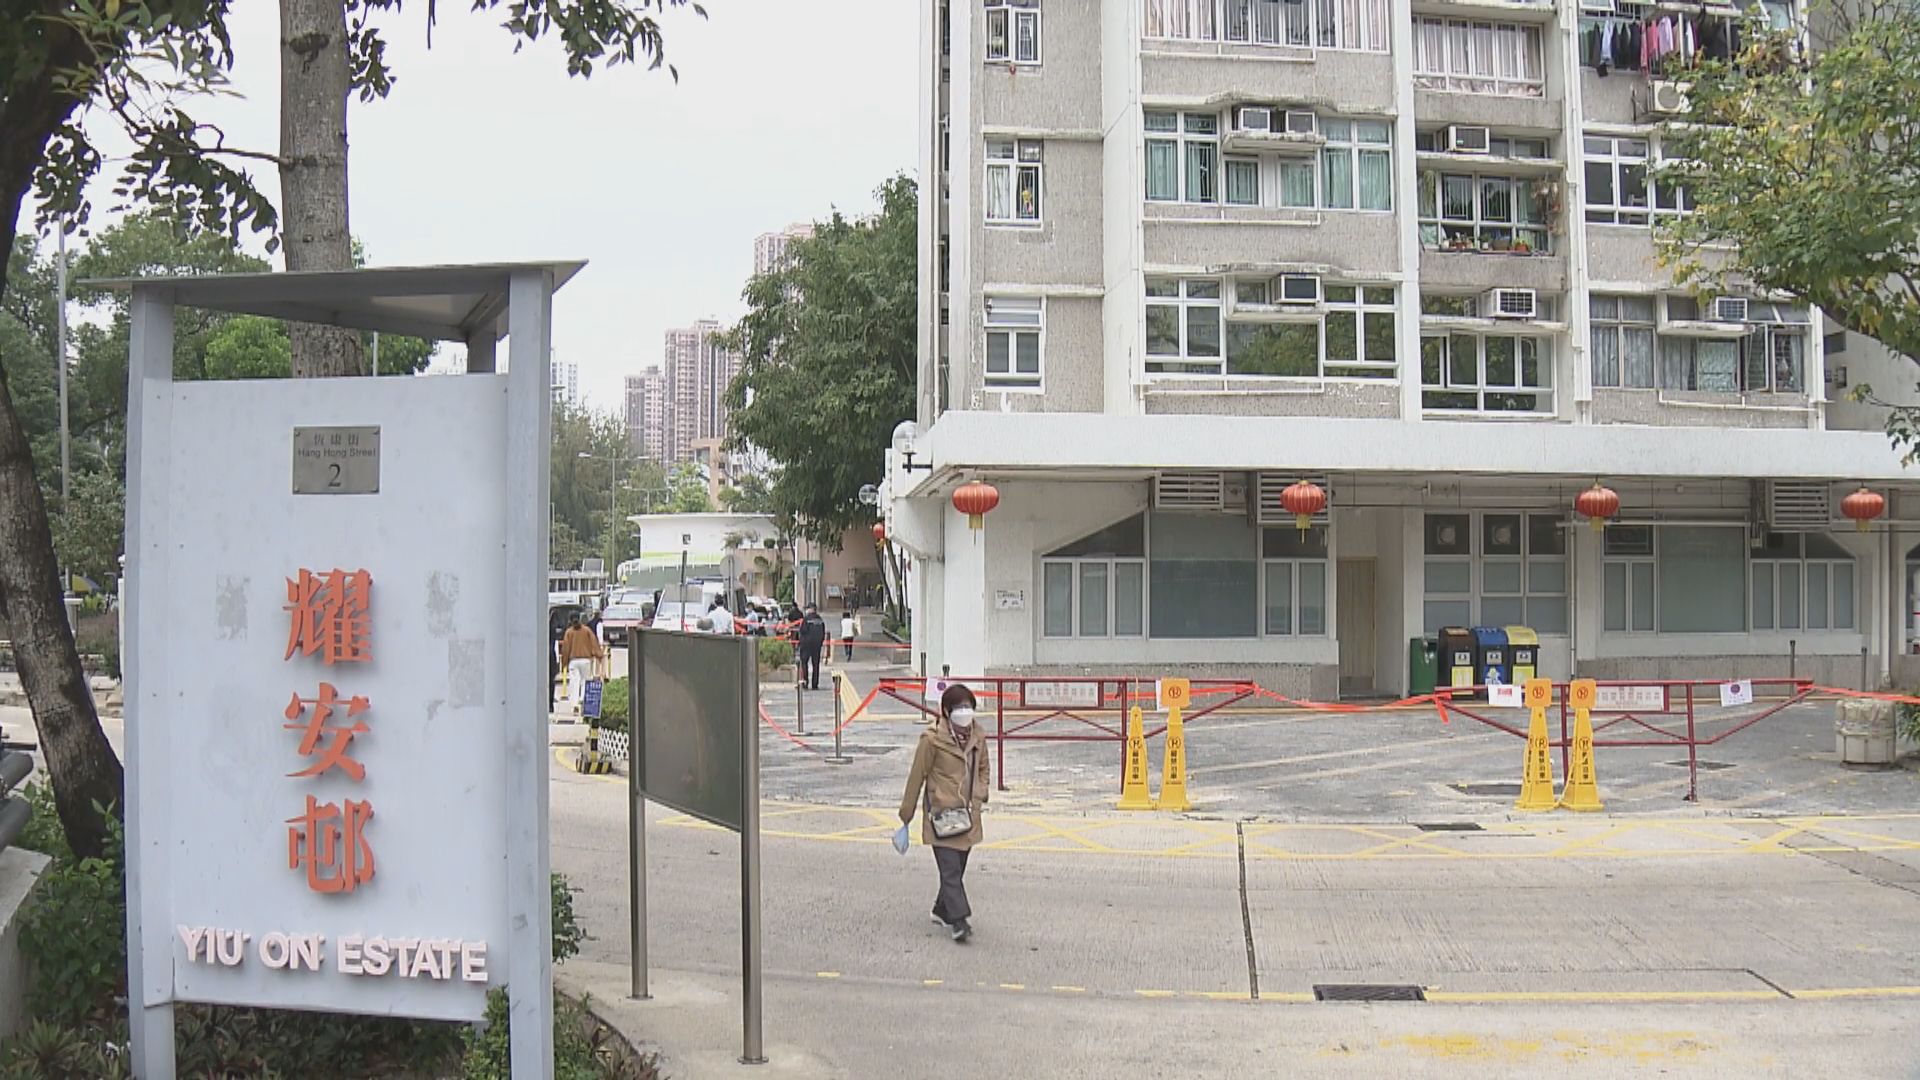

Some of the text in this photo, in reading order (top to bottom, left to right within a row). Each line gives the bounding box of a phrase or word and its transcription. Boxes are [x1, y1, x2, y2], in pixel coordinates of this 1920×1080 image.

[323, 448, 347, 459] Hong
[349, 448, 376, 457] Street
[328, 463, 341, 487] 2
[283, 567, 375, 895] 耀安邨
[177, 924, 489, 982] YIU ON ESTATE
